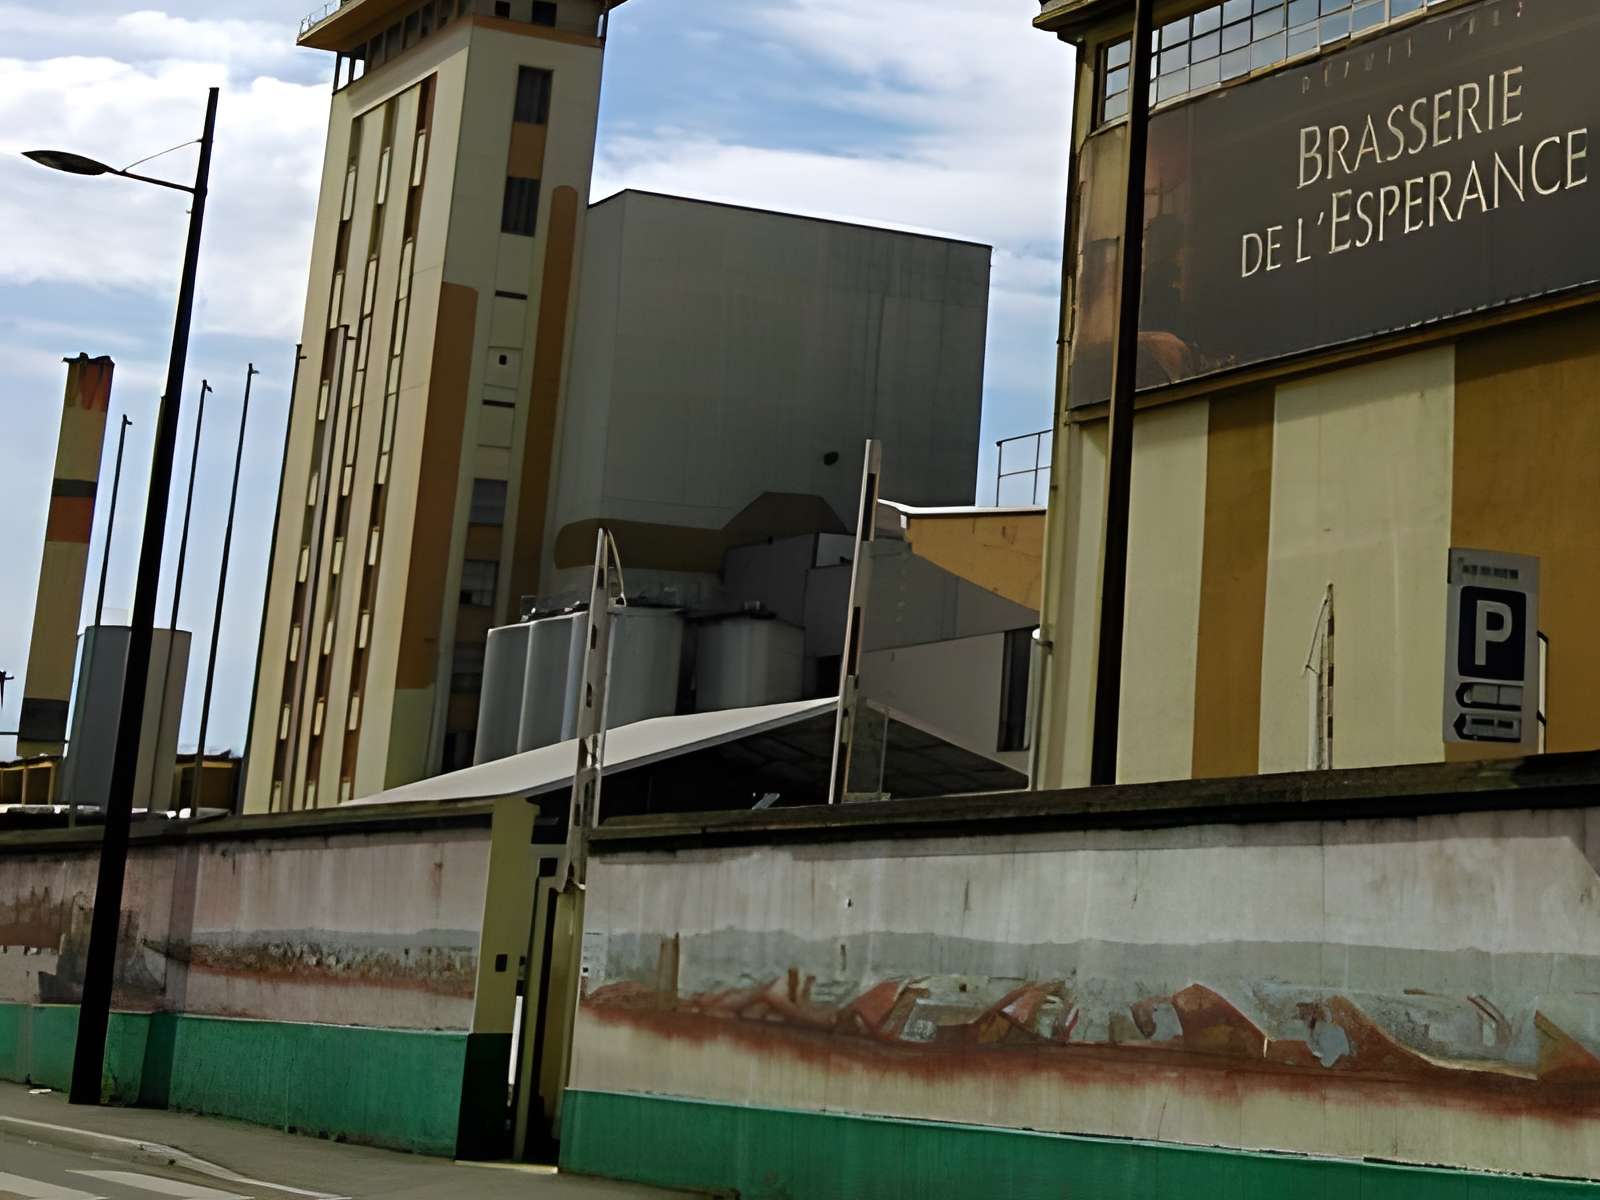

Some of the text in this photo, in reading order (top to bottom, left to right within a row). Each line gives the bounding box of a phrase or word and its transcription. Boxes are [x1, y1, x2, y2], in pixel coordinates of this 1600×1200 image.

[1297, 66, 1524, 189] BRASSERIE
[1241, 225, 1283, 277] DE
[1475, 600, 1512, 665] P
